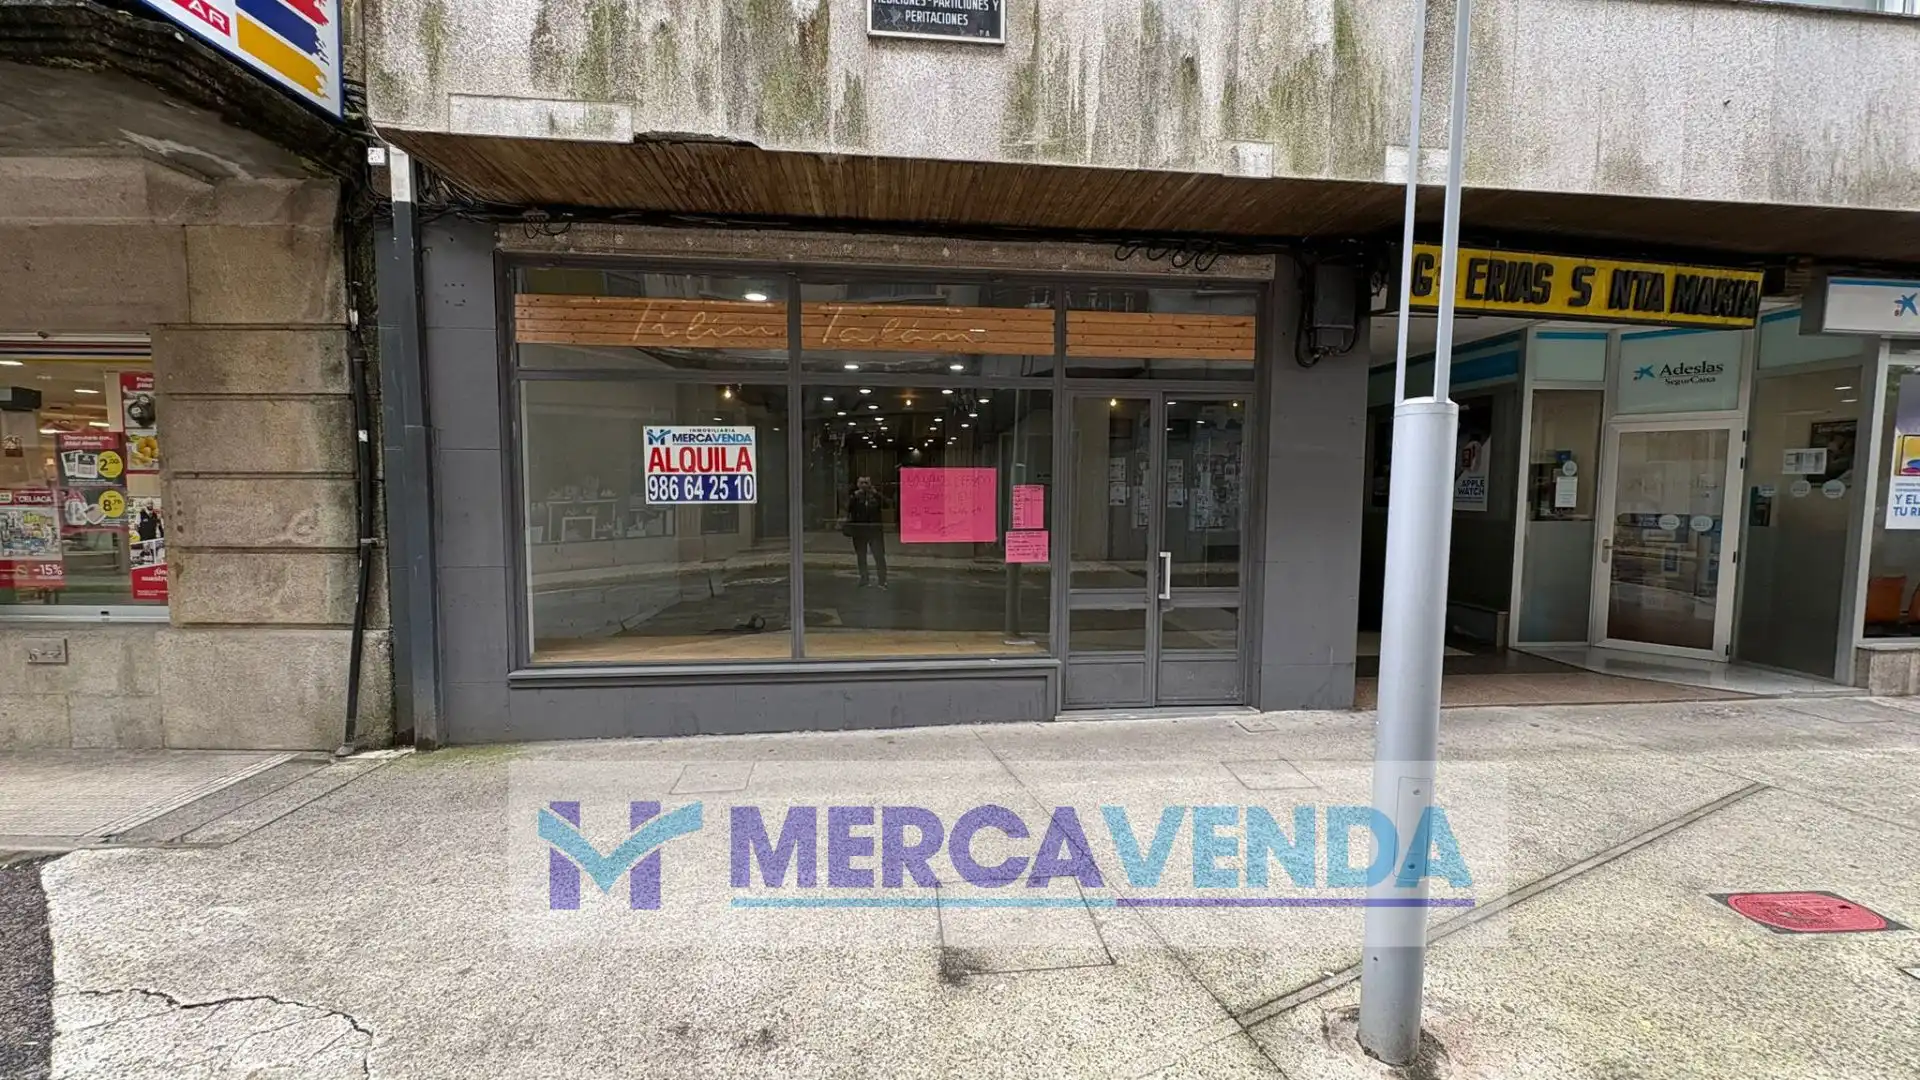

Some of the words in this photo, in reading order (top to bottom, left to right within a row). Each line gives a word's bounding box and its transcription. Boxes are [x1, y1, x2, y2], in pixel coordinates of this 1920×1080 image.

[992, 0, 999, 11] Y
[905, 10, 968, 26] PERITACIONES
[1669, 273, 1760, 319] MARIA
[1660, 361, 1725, 376] Adeslas
[672, 433, 752, 443] MERCAVENDA
[648, 446, 753, 473] ALQUILA
[648, 475, 679, 501] 986
[684, 475, 704, 500] 64
[709, 475, 729, 500] 25
[734, 475, 754, 500] 10
[1895, 494, 1903, 504] Y
[1893, 506, 1908, 517] TU
